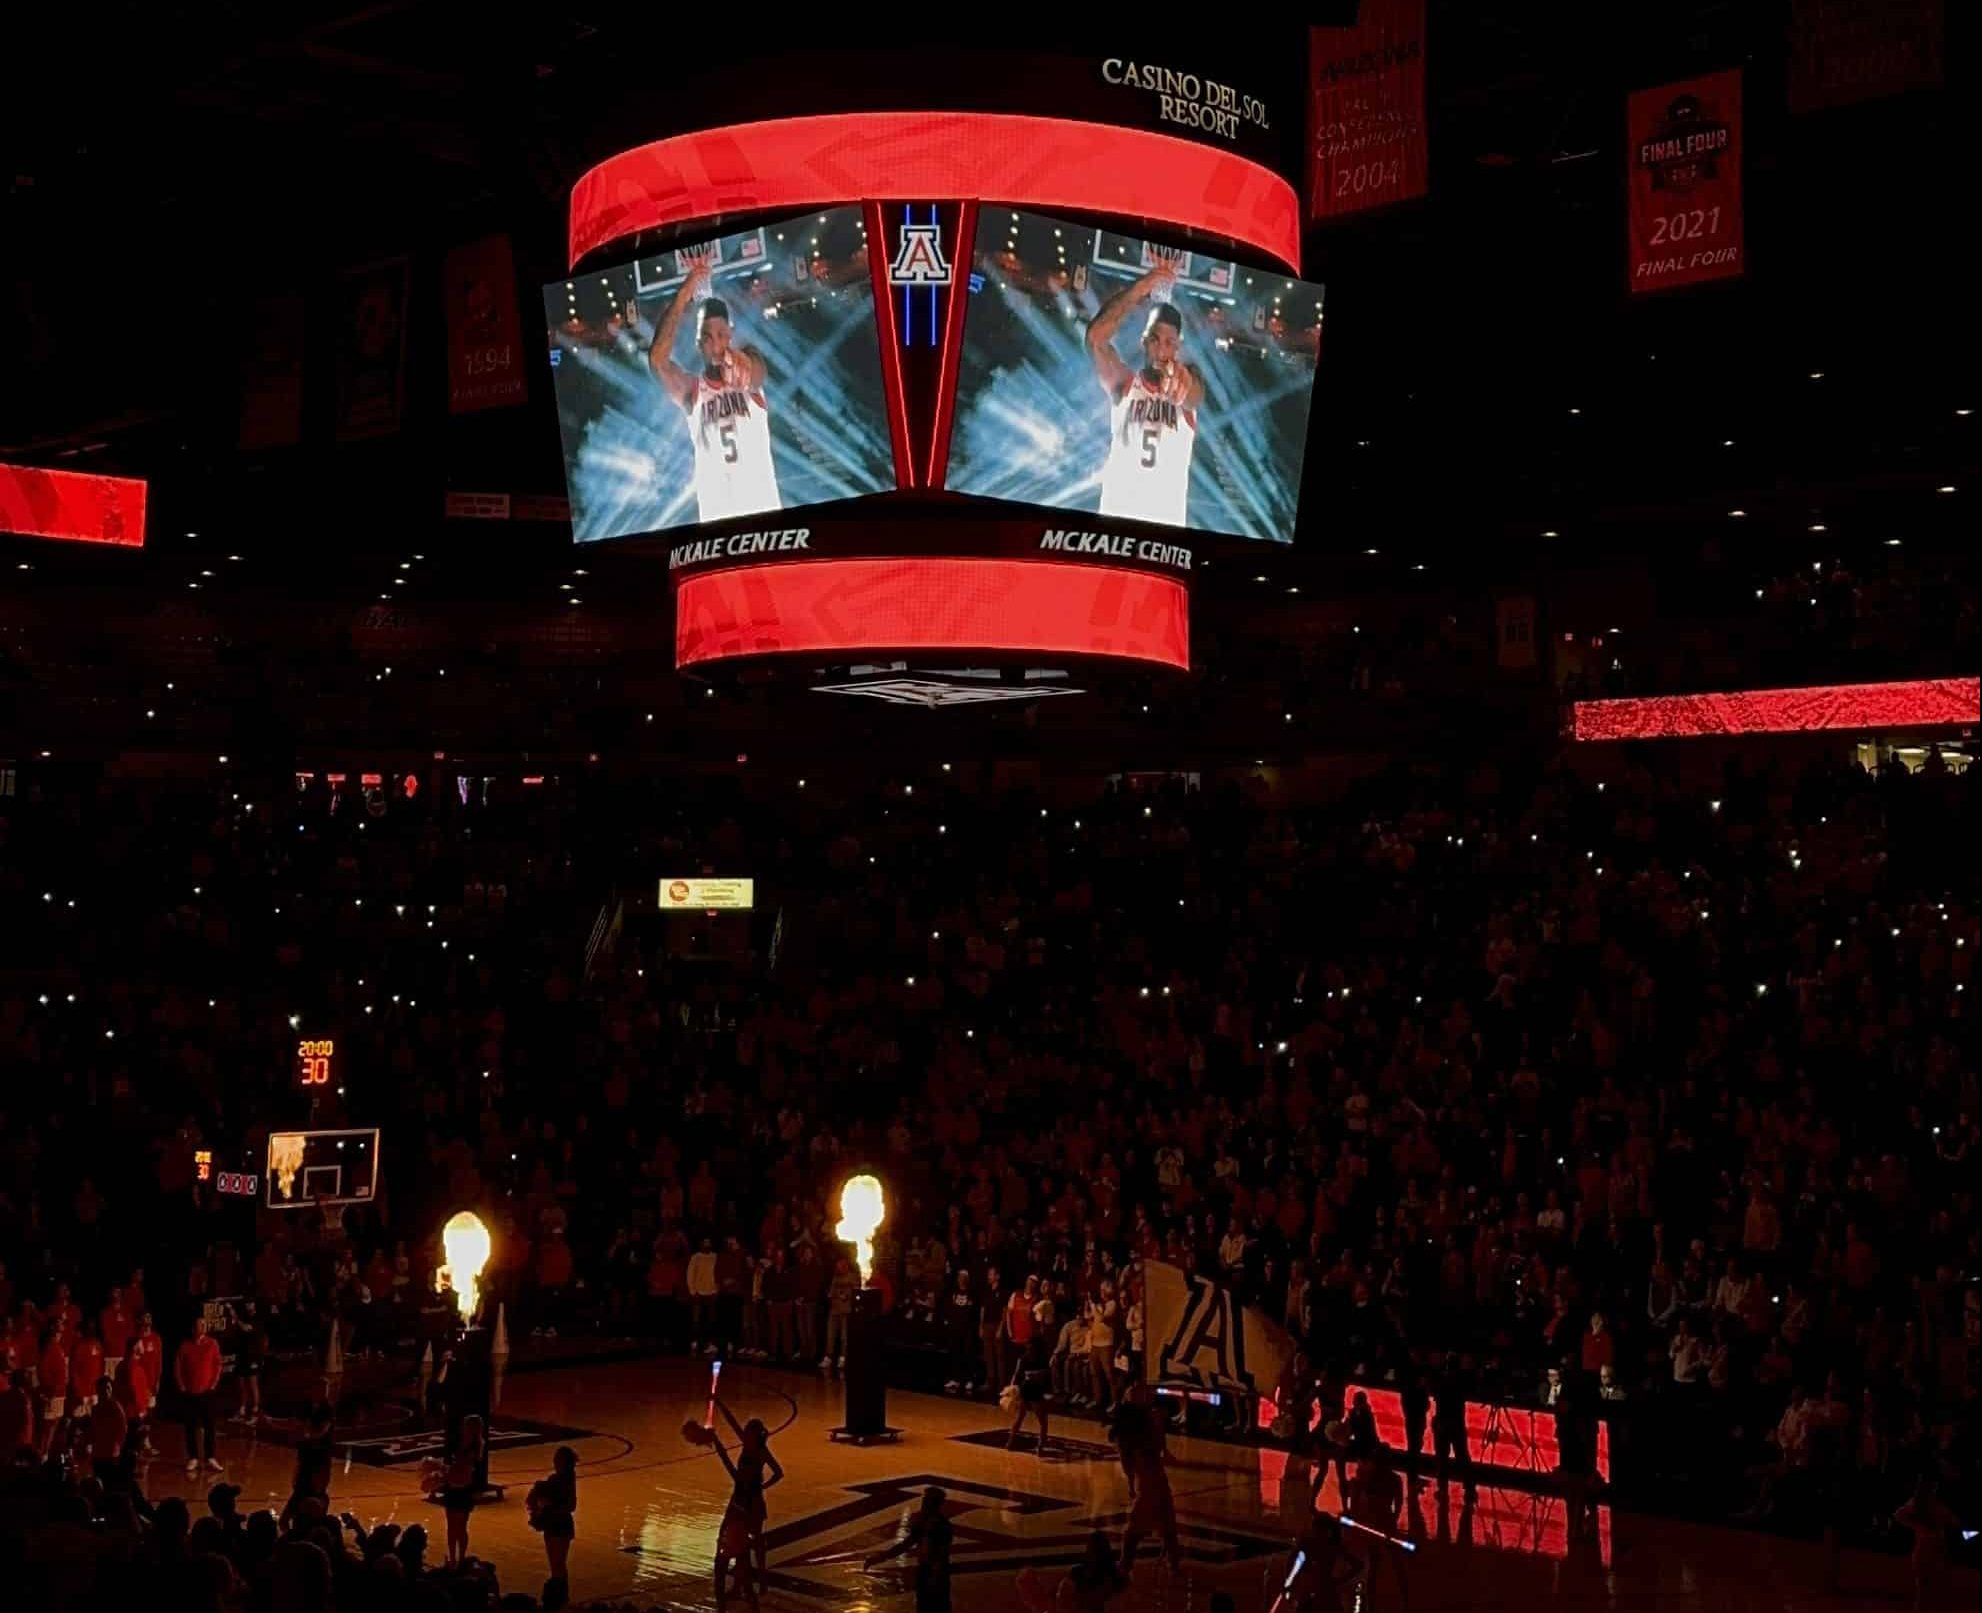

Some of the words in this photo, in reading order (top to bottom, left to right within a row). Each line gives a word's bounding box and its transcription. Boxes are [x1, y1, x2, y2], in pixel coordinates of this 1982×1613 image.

[1102, 58, 1201, 100] CASINO
[1205, 80, 1242, 115] DEL
[1243, 95, 1269, 130] SOL
[1159, 94, 1240, 140] RESORT
[1640, 136, 1685, 165] FINAL
[1686, 128, 1729, 154] FOUR
[1335, 156, 1402, 198] 2004
[1648, 205, 1721, 248] 2021
[888, 224, 953, 285] A
[1635, 256, 1687, 279] FINAL
[1690, 246, 1738, 269] FOUR
[701, 390, 752, 426] ARIZONA
[1128, 396, 1179, 433] ARIZONA
[719, 423, 739, 465] 5
[1140, 427, 1158, 469] 5
[669, 537, 726, 570] MCKALE
[726, 527, 810, 556] CENTER
[1040, 528, 1136, 558] MCKALE
[1137, 540, 1193, 570] CENTER
[297, 1040, 334, 1057] 20:00
[301, 1057, 329, 1084] 30
